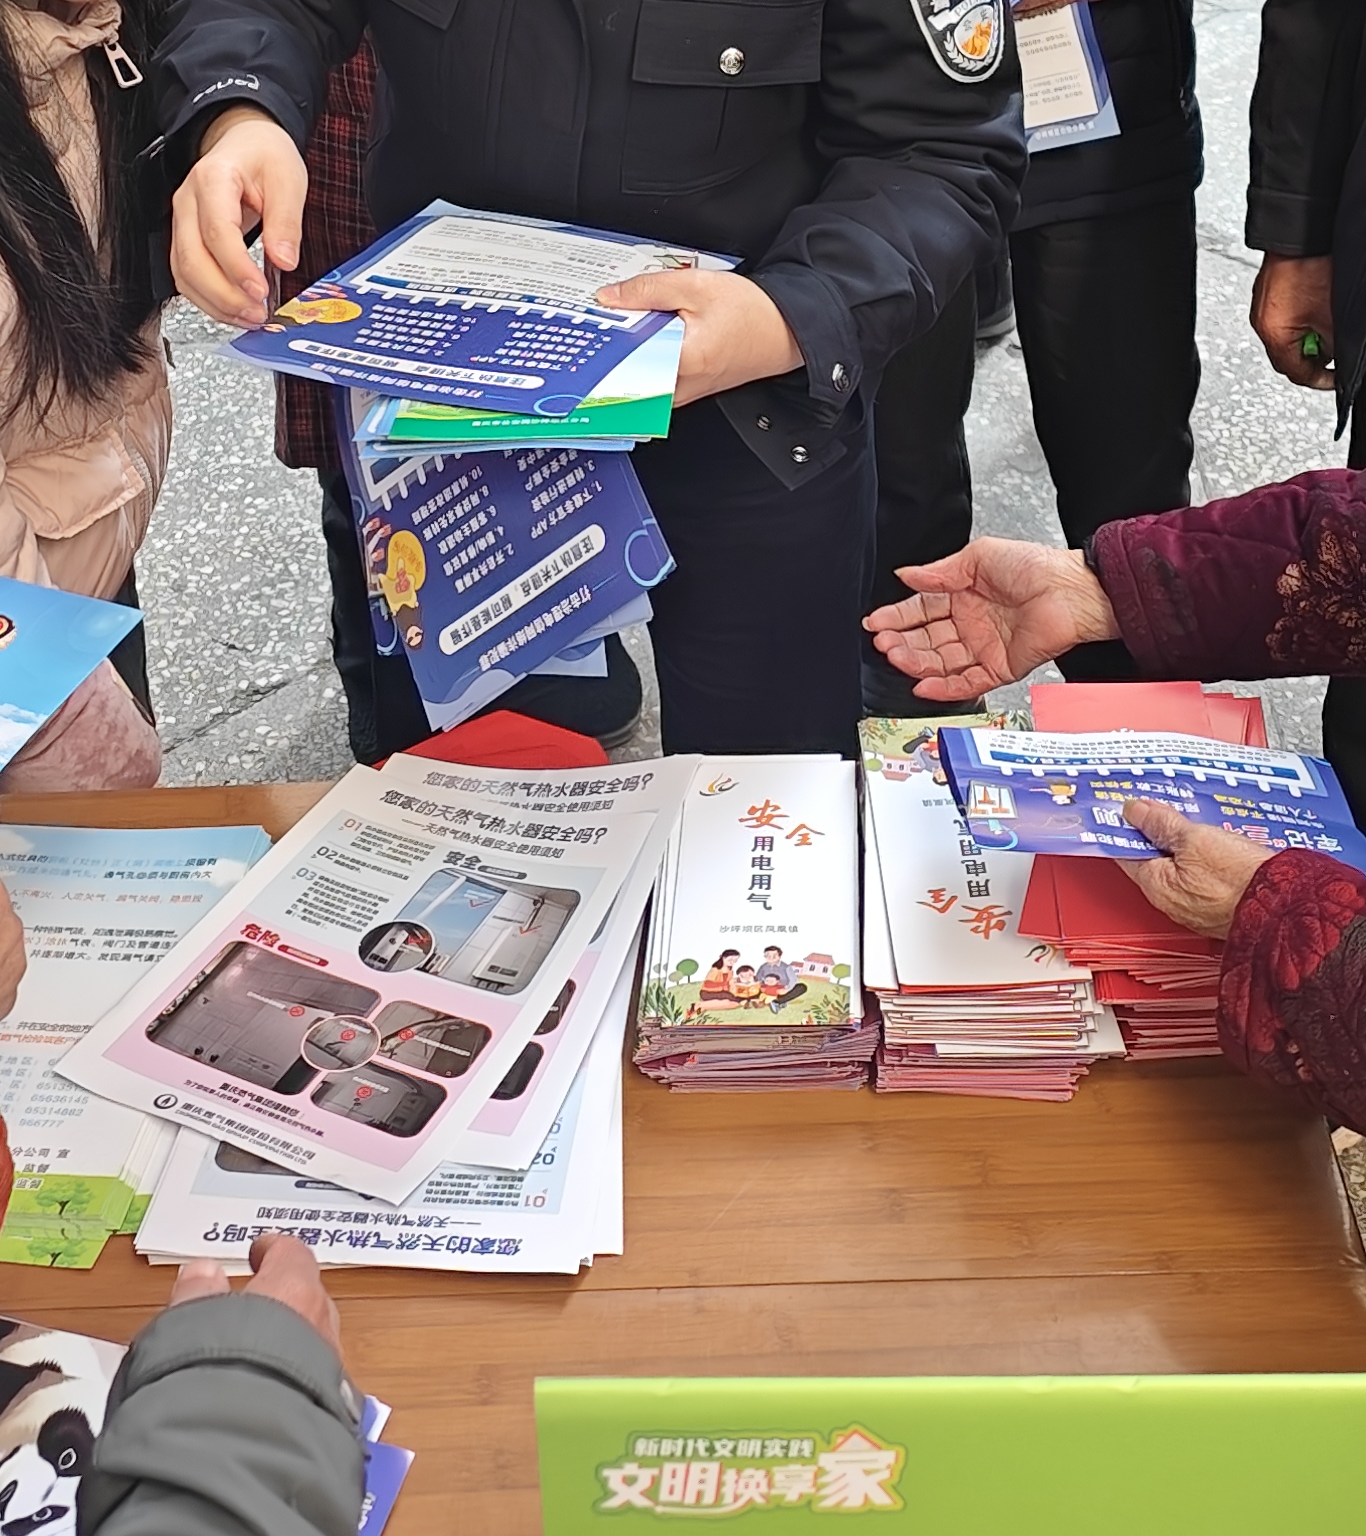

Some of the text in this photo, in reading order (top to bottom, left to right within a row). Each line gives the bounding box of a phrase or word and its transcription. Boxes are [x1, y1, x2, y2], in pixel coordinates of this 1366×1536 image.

[475, 583, 593, 672] 打击治理电信网络诈骗犯罪
[343, 819, 363, 831] 01
[738, 799, 825, 846] 安全
[316, 846, 338, 860] 02
[442, 851, 483, 871] 安全
[296, 868, 317, 881] 03
[747, 836, 775, 910] 用电用气
[916, 888, 1013, 940] 安全
[239, 924, 281, 947] 危险
[719, 925, 798, 933] 沙坪坝区凤凰镇
[181, 1102, 316, 1160] 重庆燃气集团股份有限公司
[524, 1195, 546, 1208] 01
[634, 1437, 814, 1458] 新时代文明实践
[601, 1429, 898, 1508] 文明换享家
